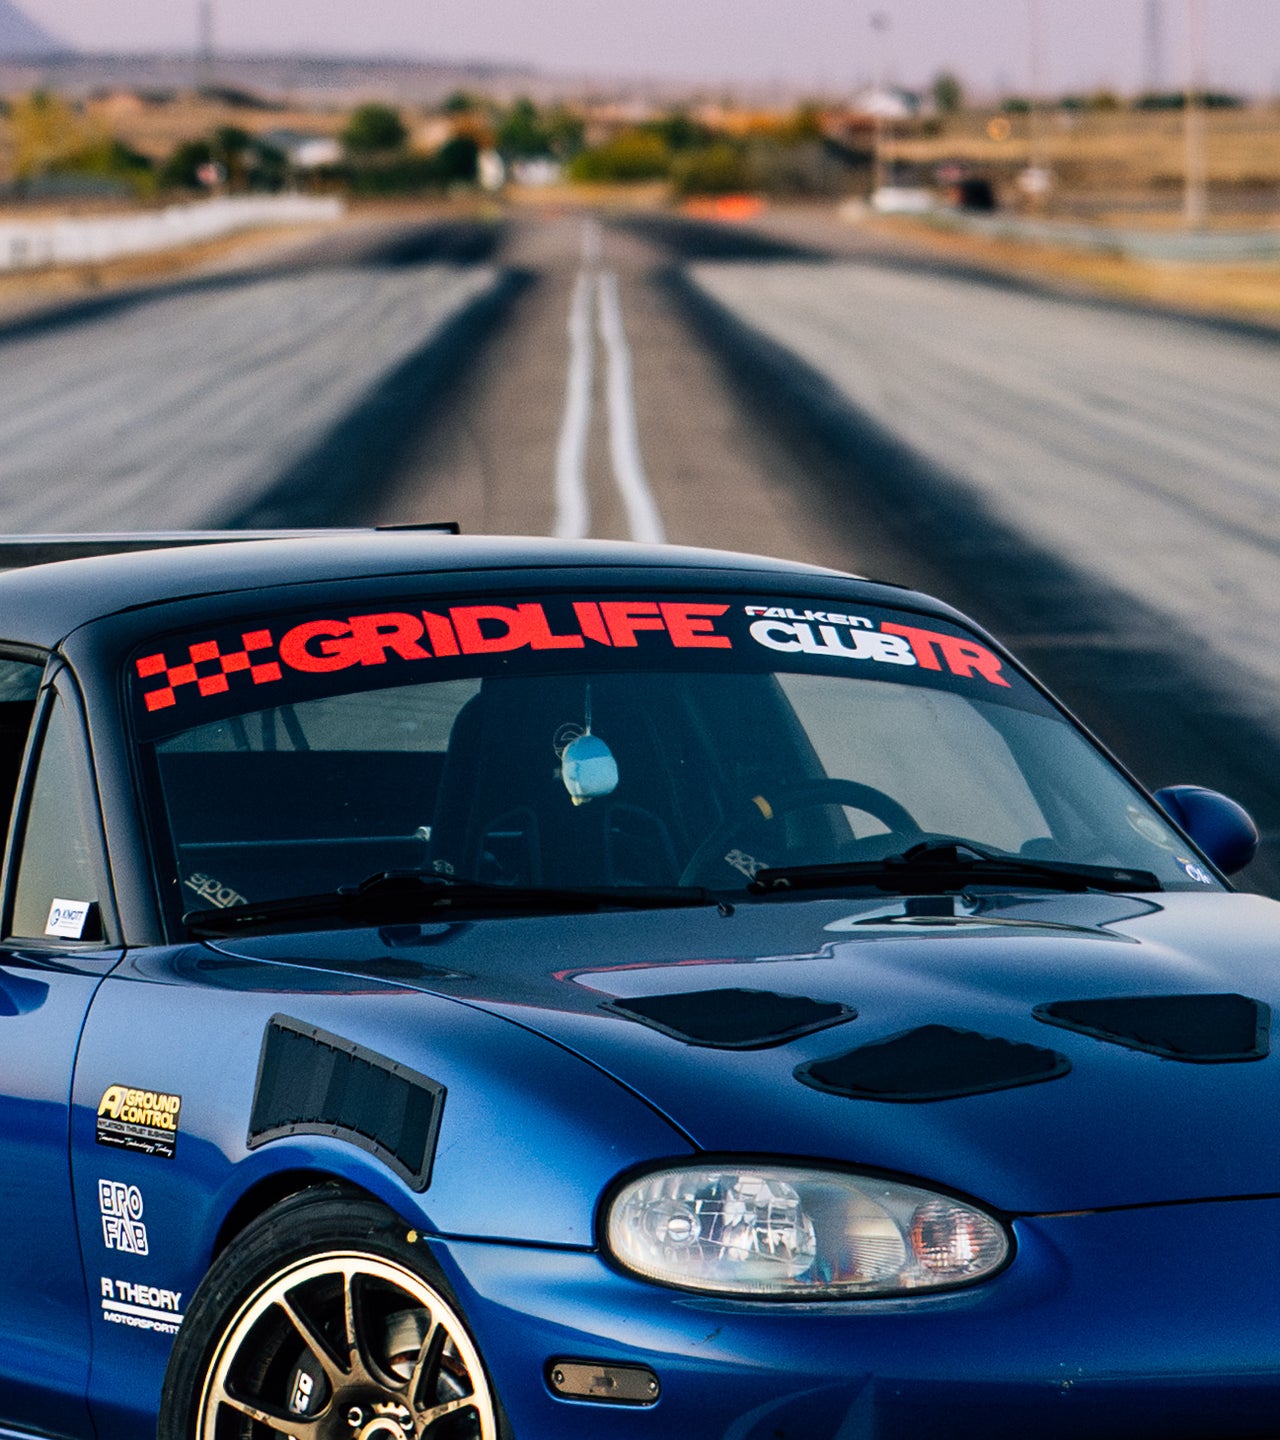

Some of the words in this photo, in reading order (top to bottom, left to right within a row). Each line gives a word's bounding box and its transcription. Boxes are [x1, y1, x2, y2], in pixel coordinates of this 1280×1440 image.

[743, 605, 874, 628] FALKEN
[279, 601, 733, 674] GRIDLIFE
[121, 1105, 176, 1131] CONTROL
[125, 1089, 180, 1114] GROUND
[98, 1179, 144, 1221] BRO
[101, 1214, 149, 1256] FAB
[101, 1276, 114, 1299] R
[115, 1280, 182, 1312] THEORY
